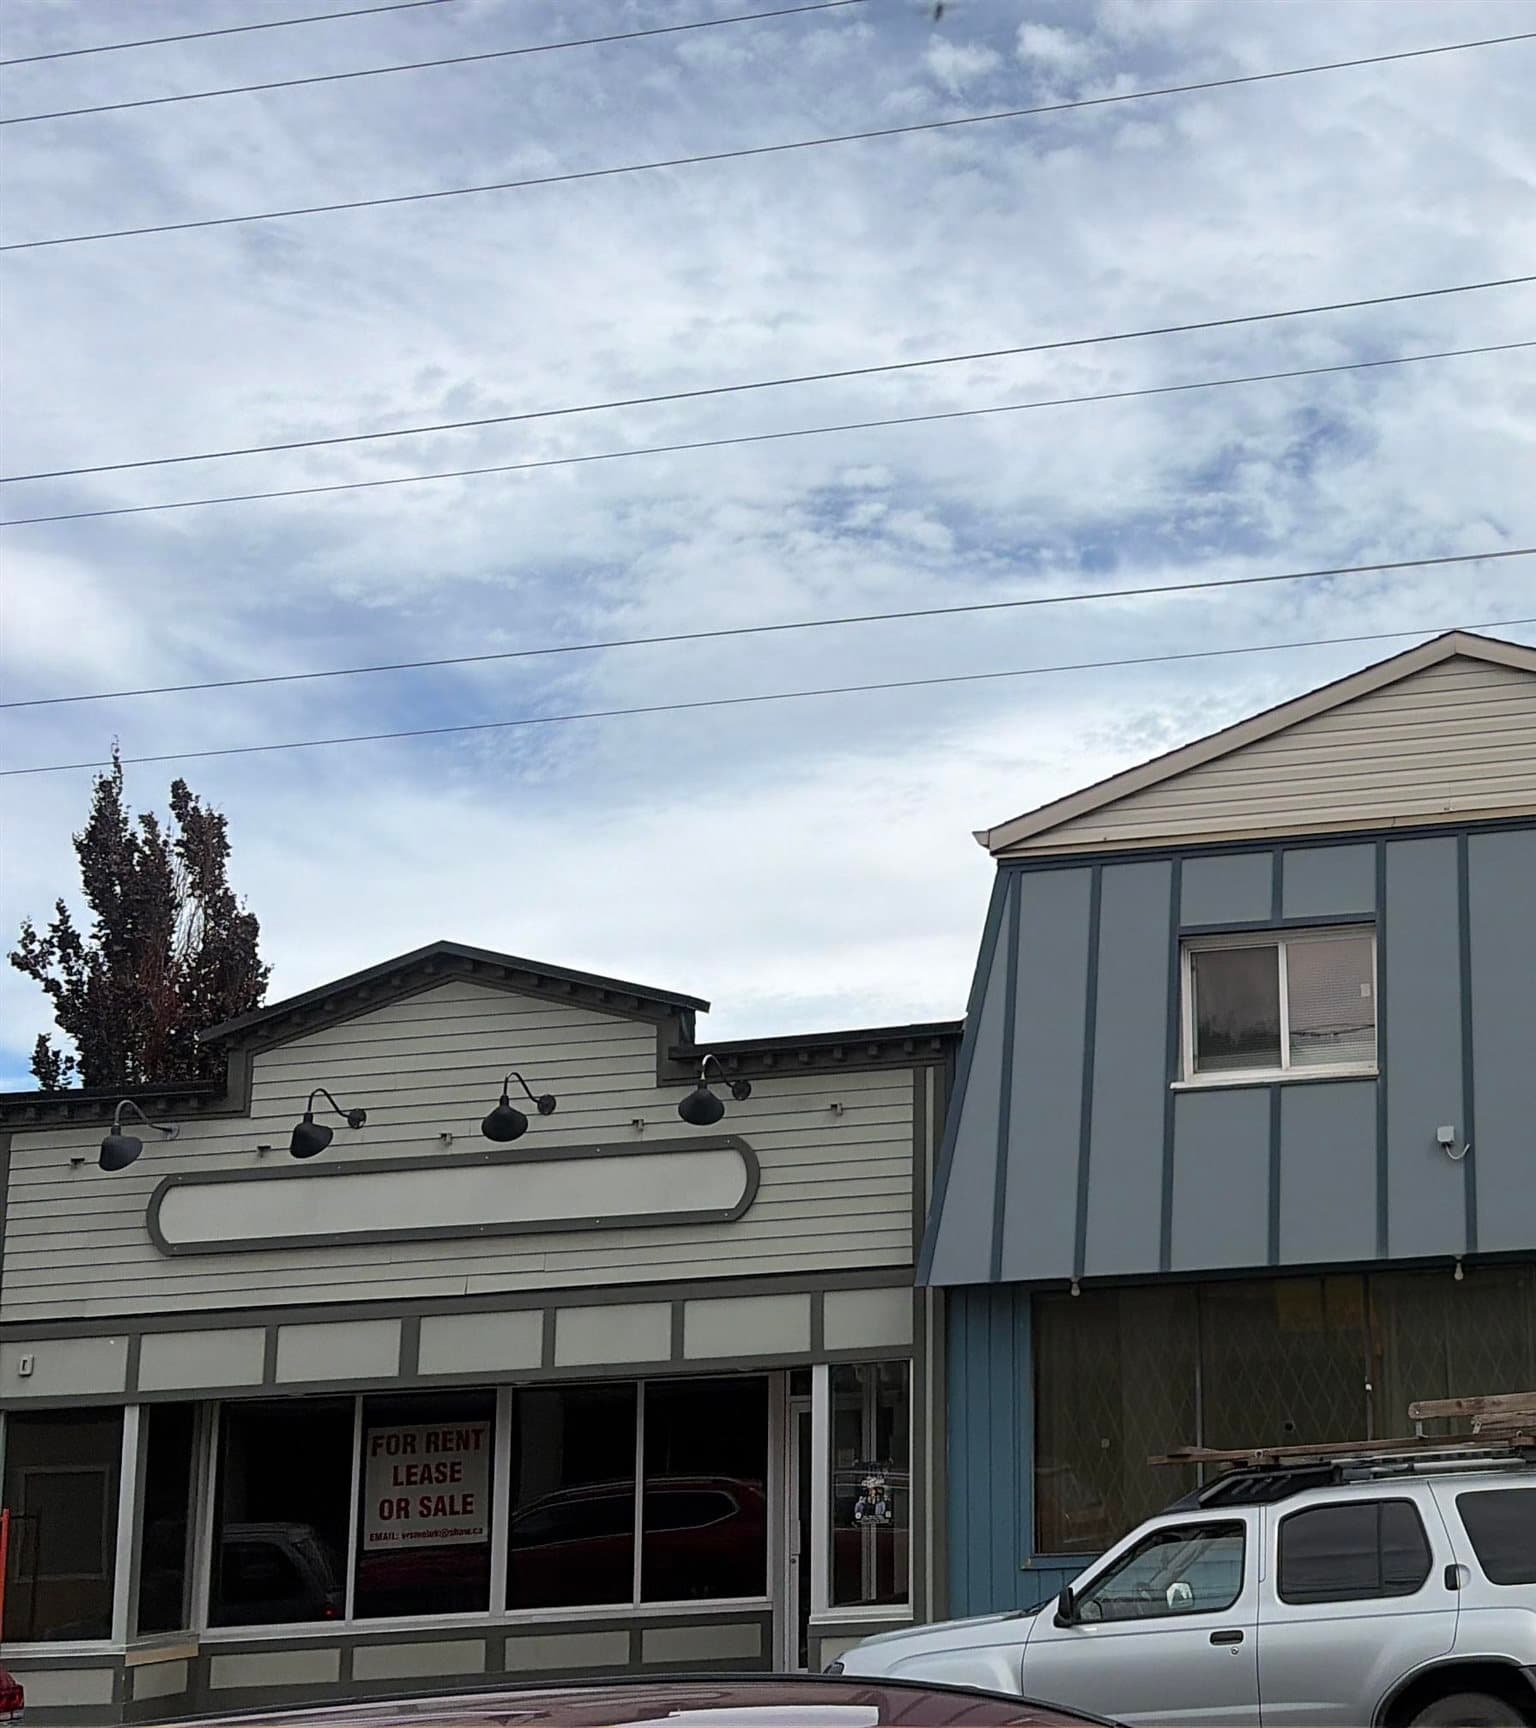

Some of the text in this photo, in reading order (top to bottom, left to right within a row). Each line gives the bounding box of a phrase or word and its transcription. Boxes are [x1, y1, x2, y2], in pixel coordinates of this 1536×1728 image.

[370, 1429, 485, 1457] FOR RENT
[392, 1462, 462, 1487] LEASE
[379, 1494, 475, 1521] OR SALE
[369, 1531, 399, 1542] EMAIL:
